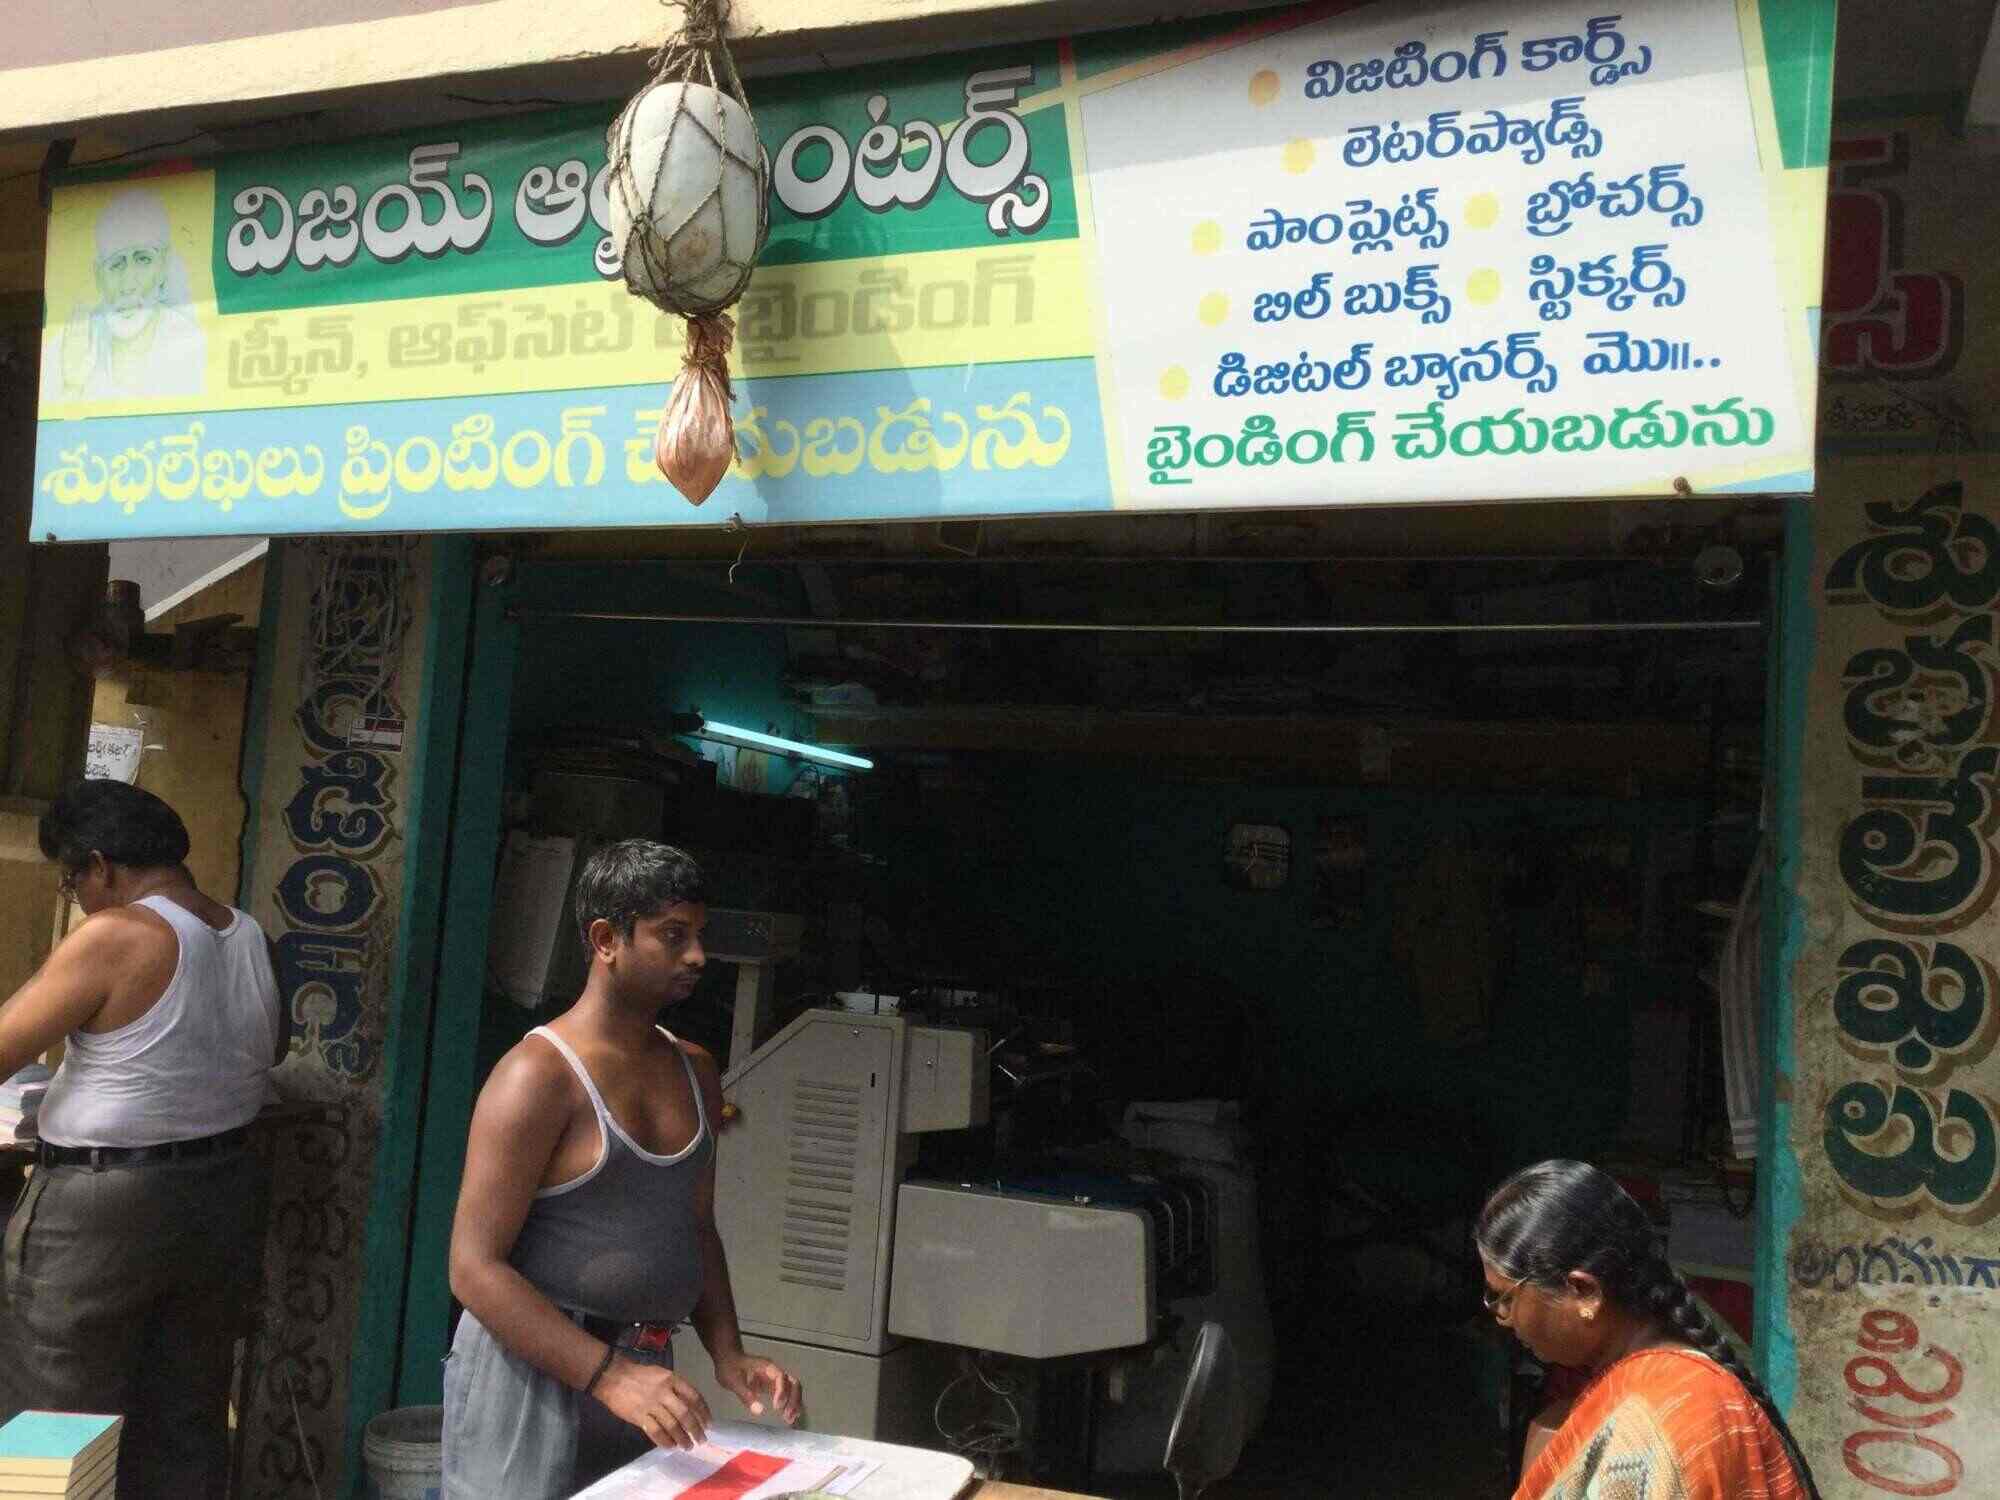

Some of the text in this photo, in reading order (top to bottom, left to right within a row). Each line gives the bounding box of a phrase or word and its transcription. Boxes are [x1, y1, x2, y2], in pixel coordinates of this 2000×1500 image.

[1304, 15, 1653, 99] విజిటింగ్ కార్డ్స్
[226, 141, 493, 275] విజయ్
[762, 63, 1050, 235] ంటర్స్
[1526, 163, 1704, 237] బ్రోచర్స్
[1246, 187, 1450, 255] పాంప్లెట్స్
[1253, 263, 1453, 325] బిల్ బుక్స్
[1528, 243, 1686, 321] స్టిక్కర్స్
[1213, 343, 1373, 398] డిజిటల్
[1384, 331, 1558, 400] బ్యానర్స్
[42, 421, 326, 515] శుభలేఖలు
[338, 405, 608, 519] ప్రింటింగ్
[1146, 410, 1377, 486] బైండింగ్
[1392, 396, 1775, 462] చేయబడును
